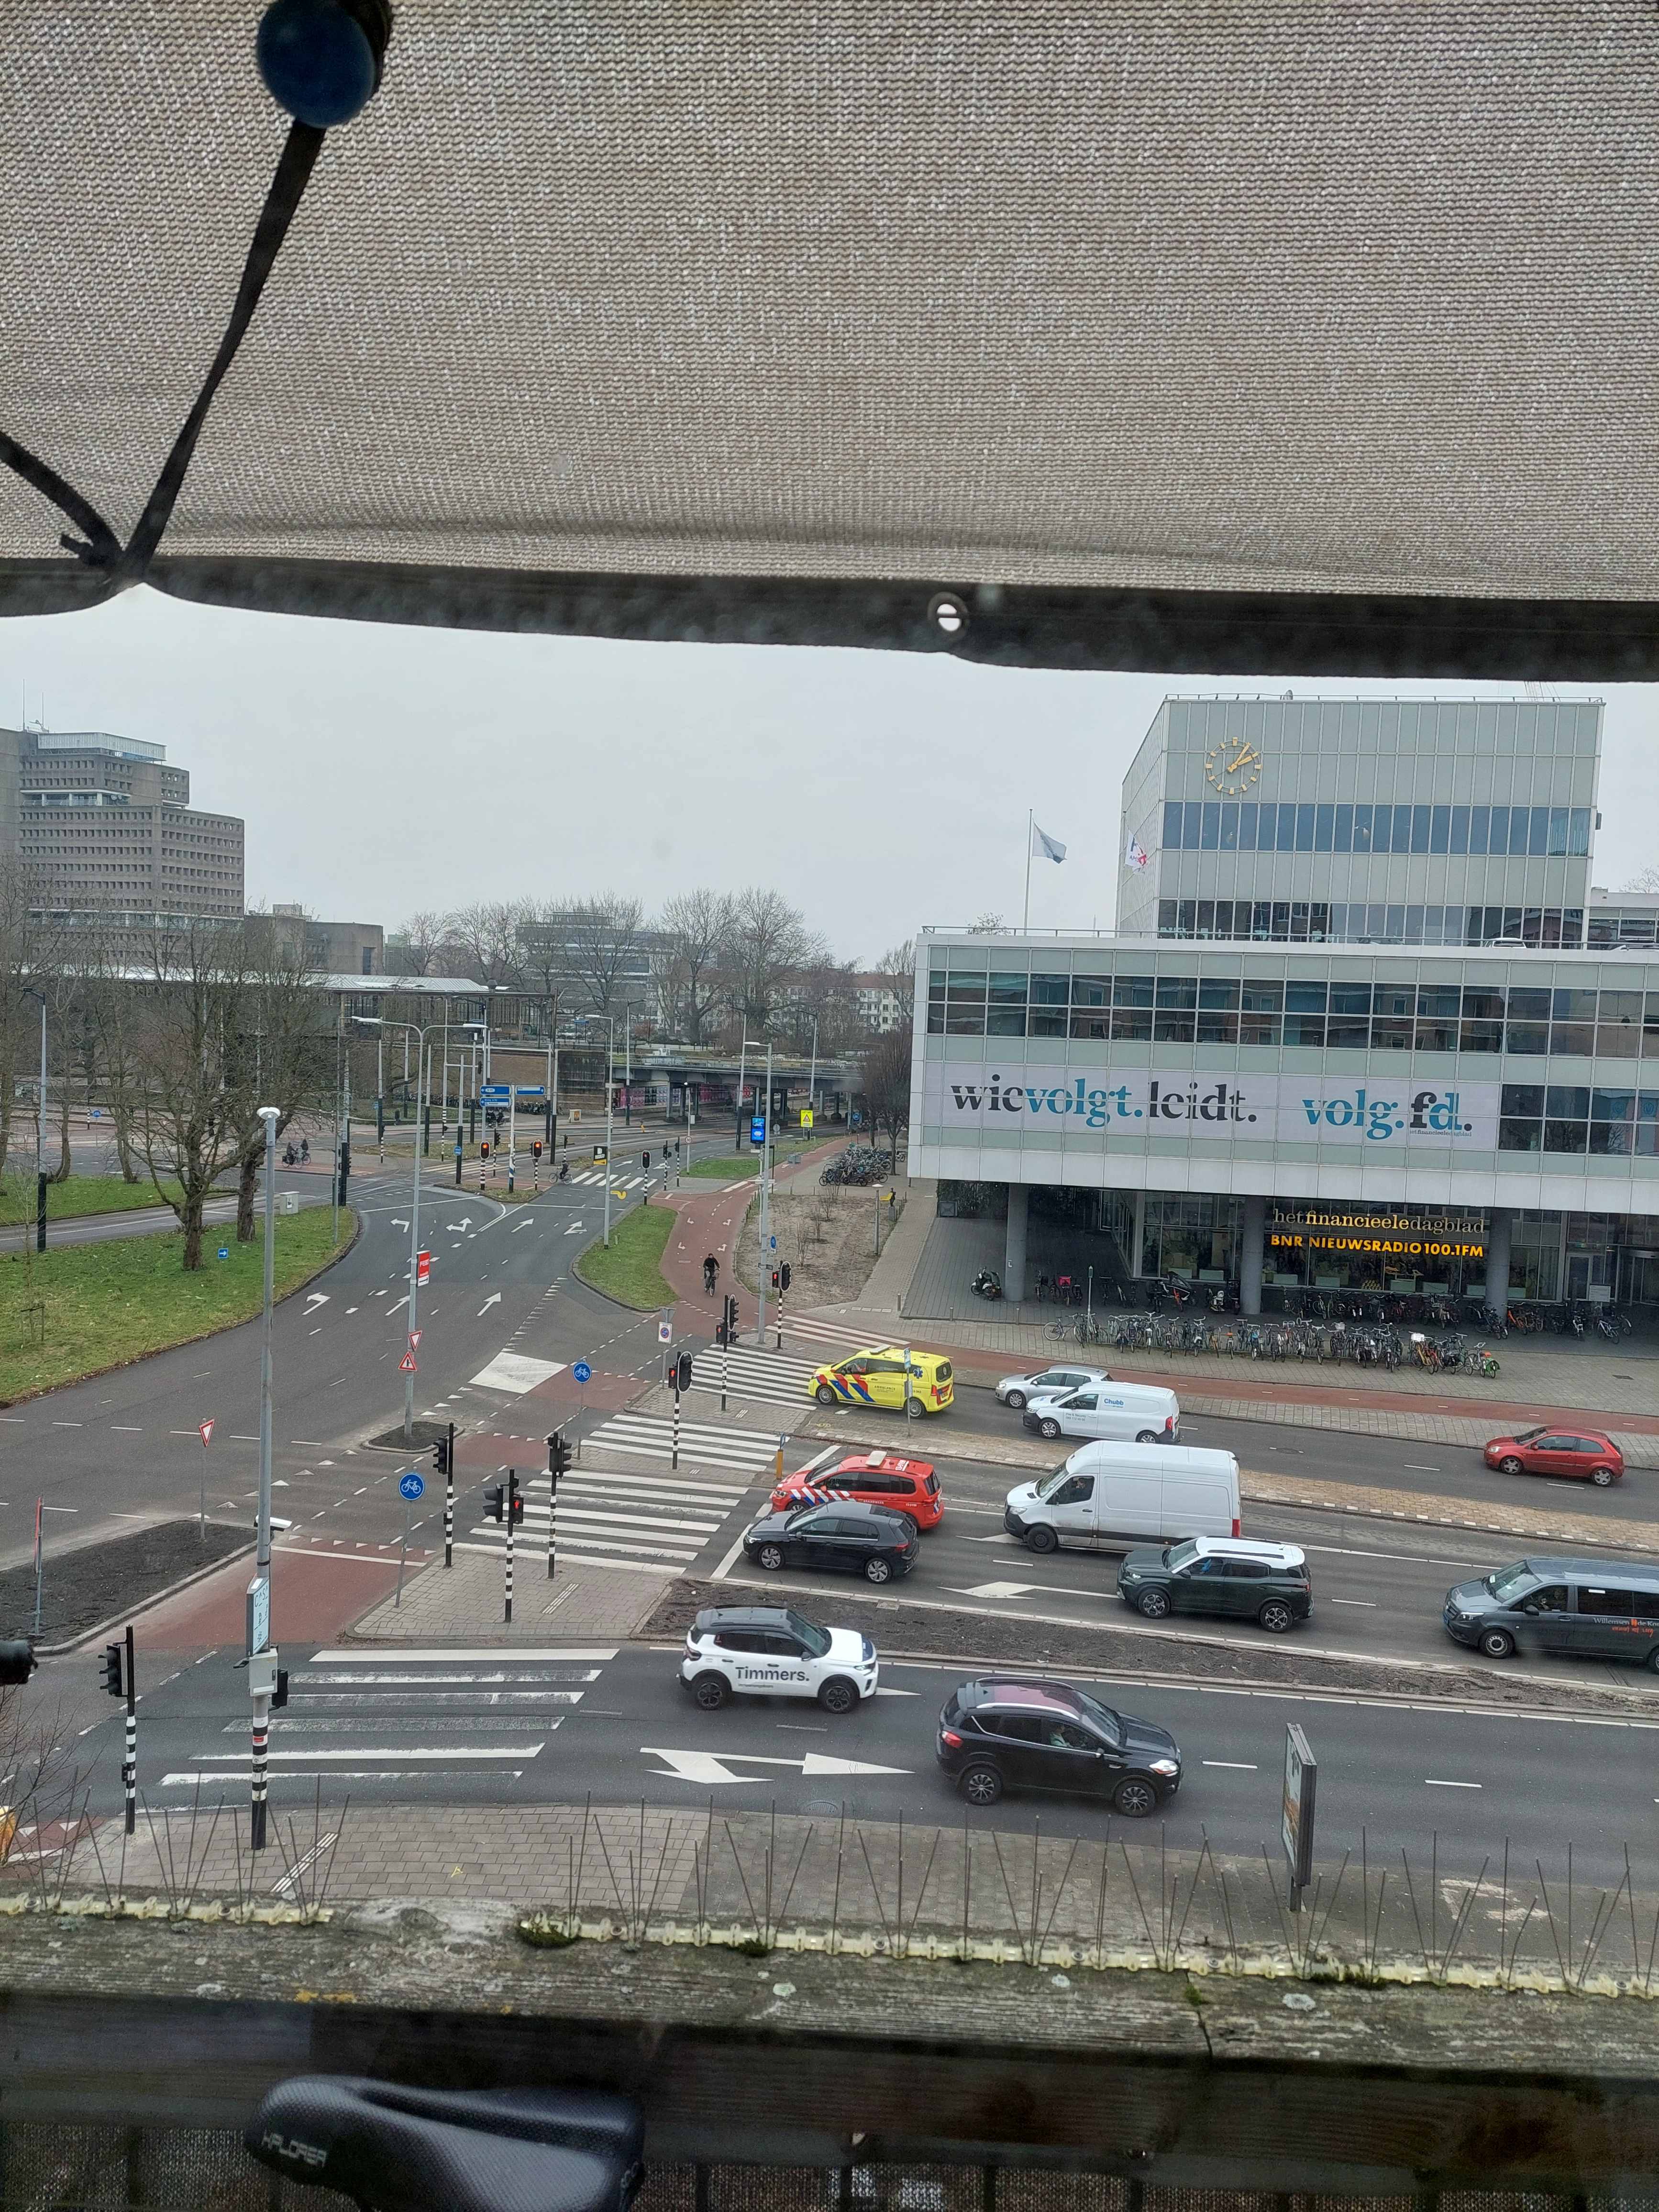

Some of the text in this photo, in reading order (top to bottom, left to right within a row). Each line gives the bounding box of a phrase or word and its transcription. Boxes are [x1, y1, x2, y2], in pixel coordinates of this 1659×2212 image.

[1271, 1235, 1483, 1257] BNR NIEUWSRADIO 100.1FM
[1593, 1617, 1630, 1626] Willemsen
[735, 1666, 810, 1681] Timmers.
